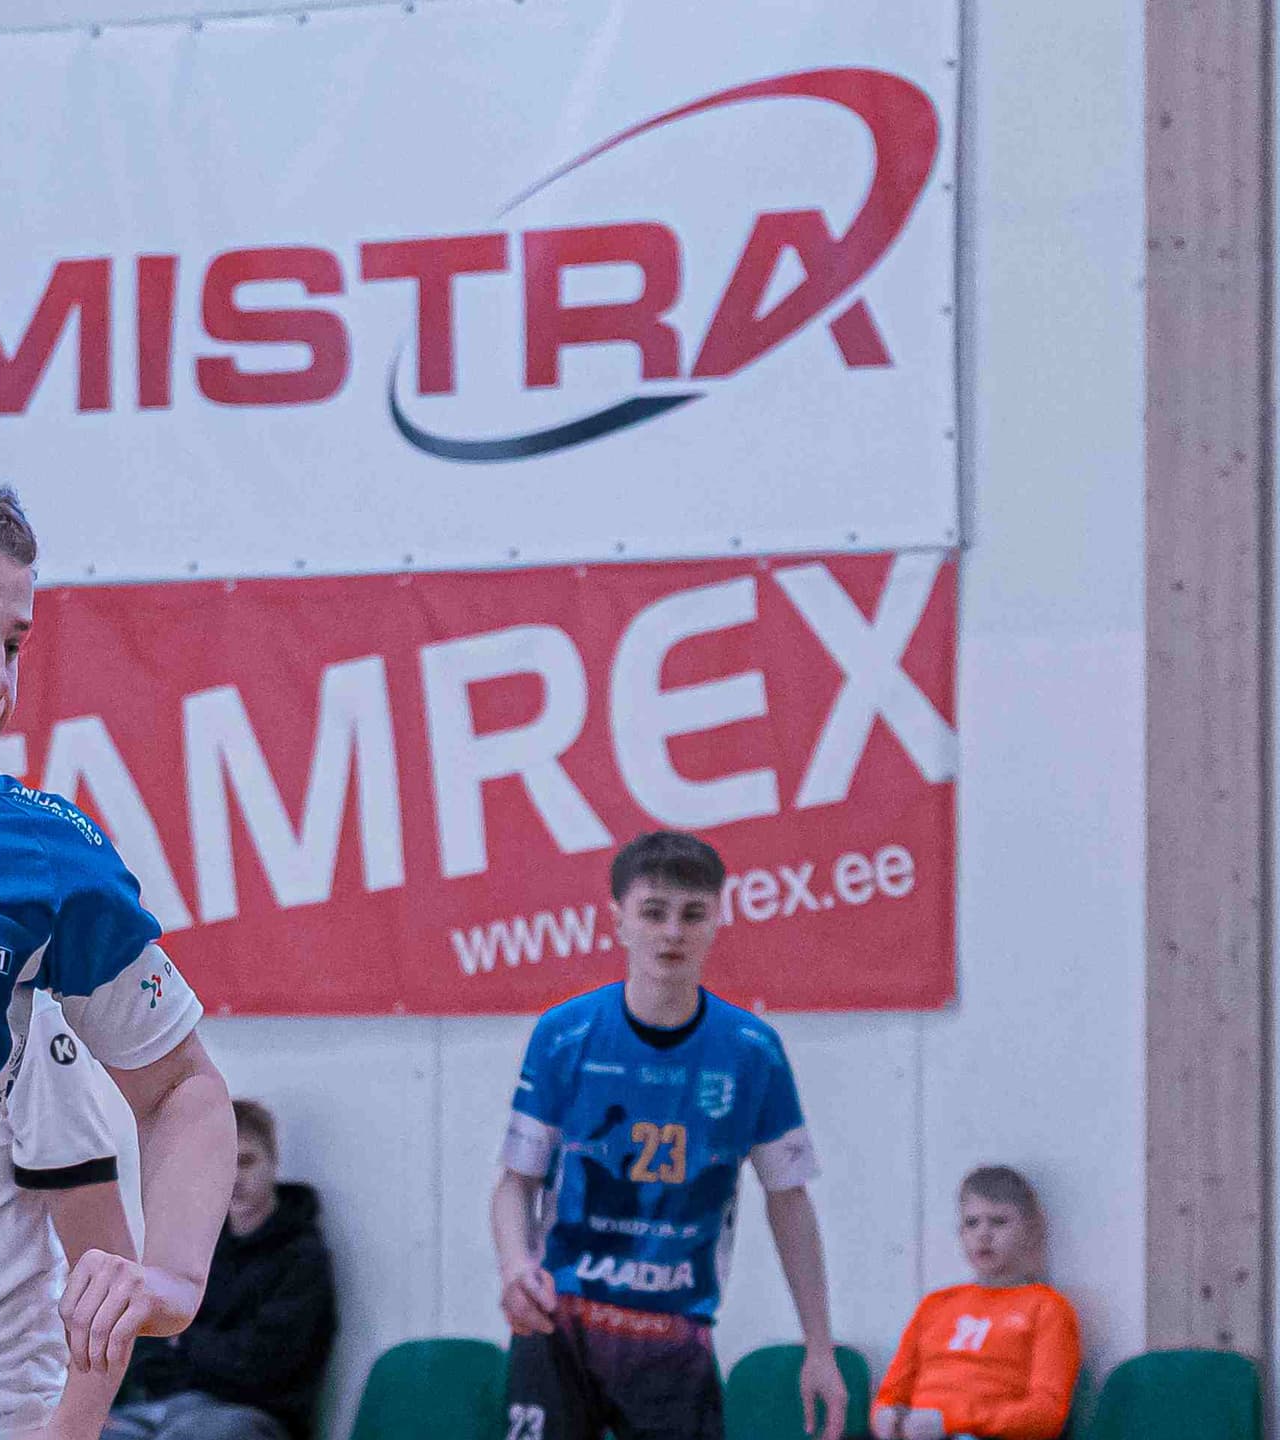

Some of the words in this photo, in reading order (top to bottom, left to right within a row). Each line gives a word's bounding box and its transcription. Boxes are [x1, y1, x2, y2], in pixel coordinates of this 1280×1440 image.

[9, 787, 62, 811] ANIJA
[67, 809, 104, 847] VALD
[451, 844, 916, 977] www.rex.ee
[629, 1121, 687, 1184] 23
